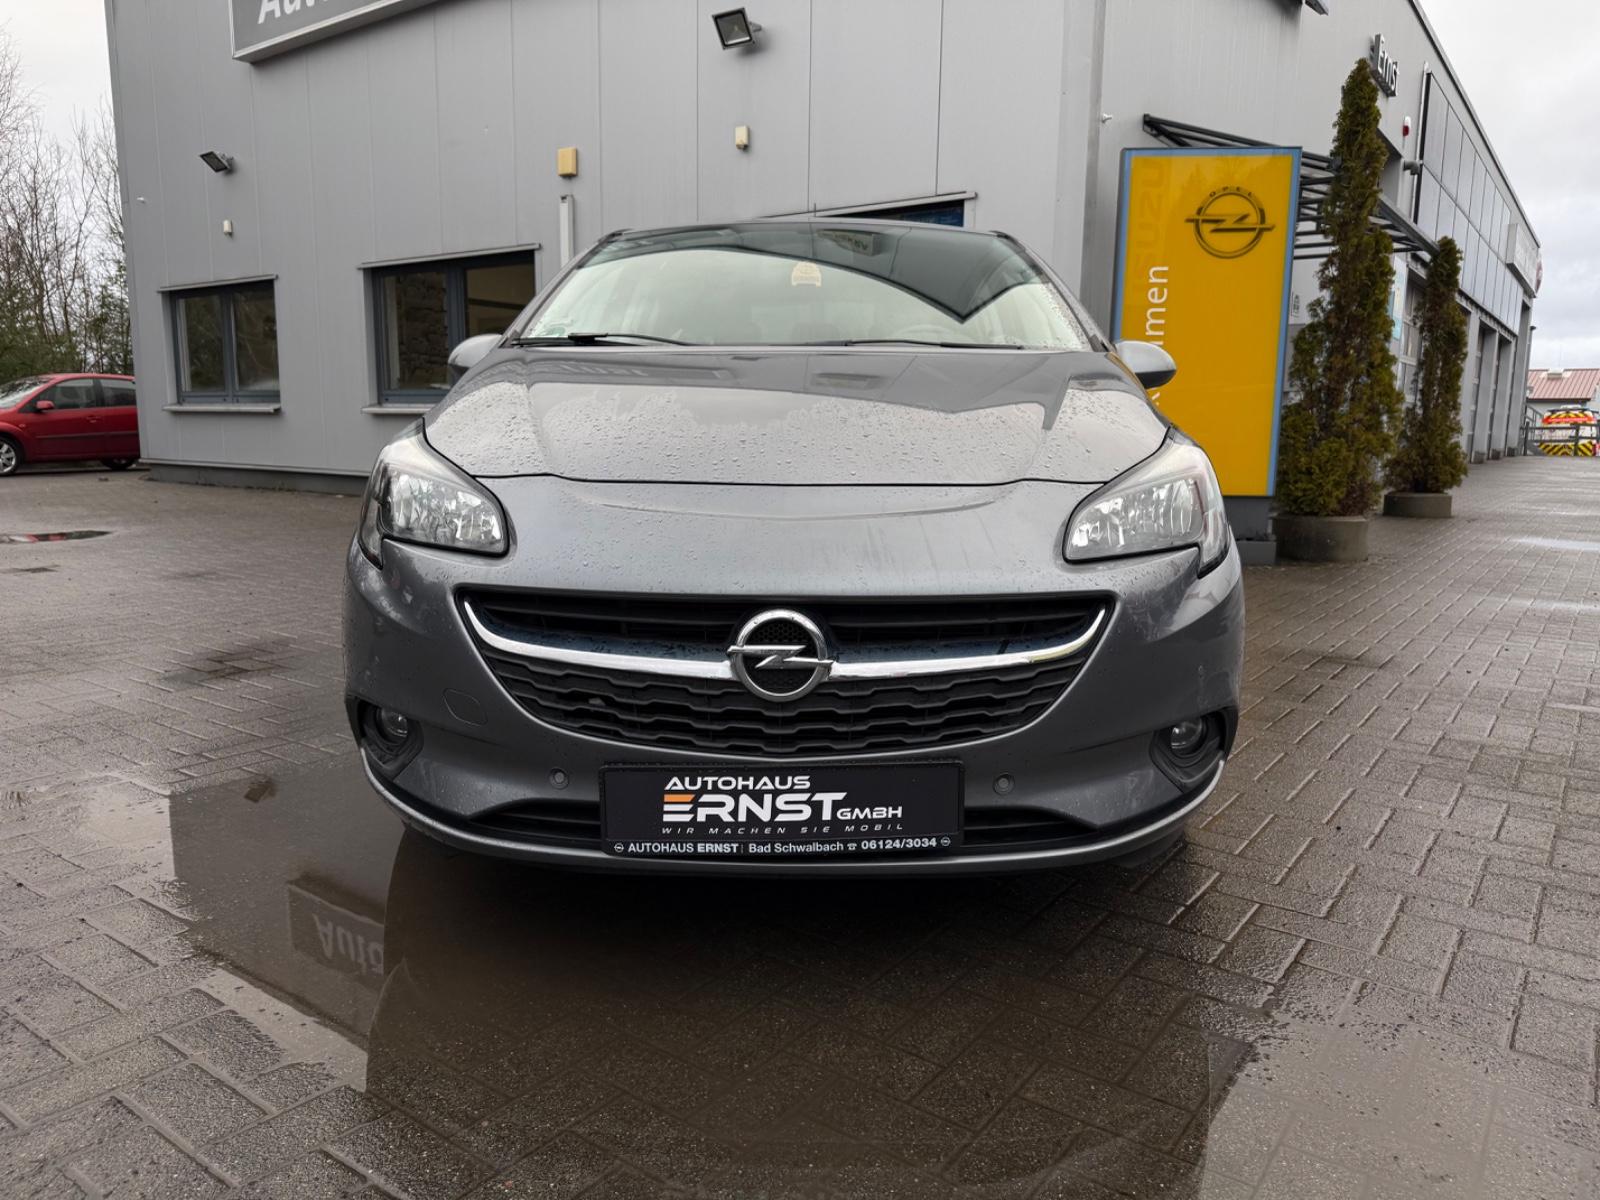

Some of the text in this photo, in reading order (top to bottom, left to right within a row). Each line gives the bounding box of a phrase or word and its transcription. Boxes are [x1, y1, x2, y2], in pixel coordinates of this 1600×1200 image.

[257, 0, 329, 25] Au
[663, 775, 811, 791] AUTOHAUS
[662, 792, 903, 822] ERNST GMBH
[661, 823, 903, 835] WIR MACHEN SIE MOBIL
[628, 837, 937, 853] AUTOHAUS ERNST Bad Schwalbach 06124/3034
